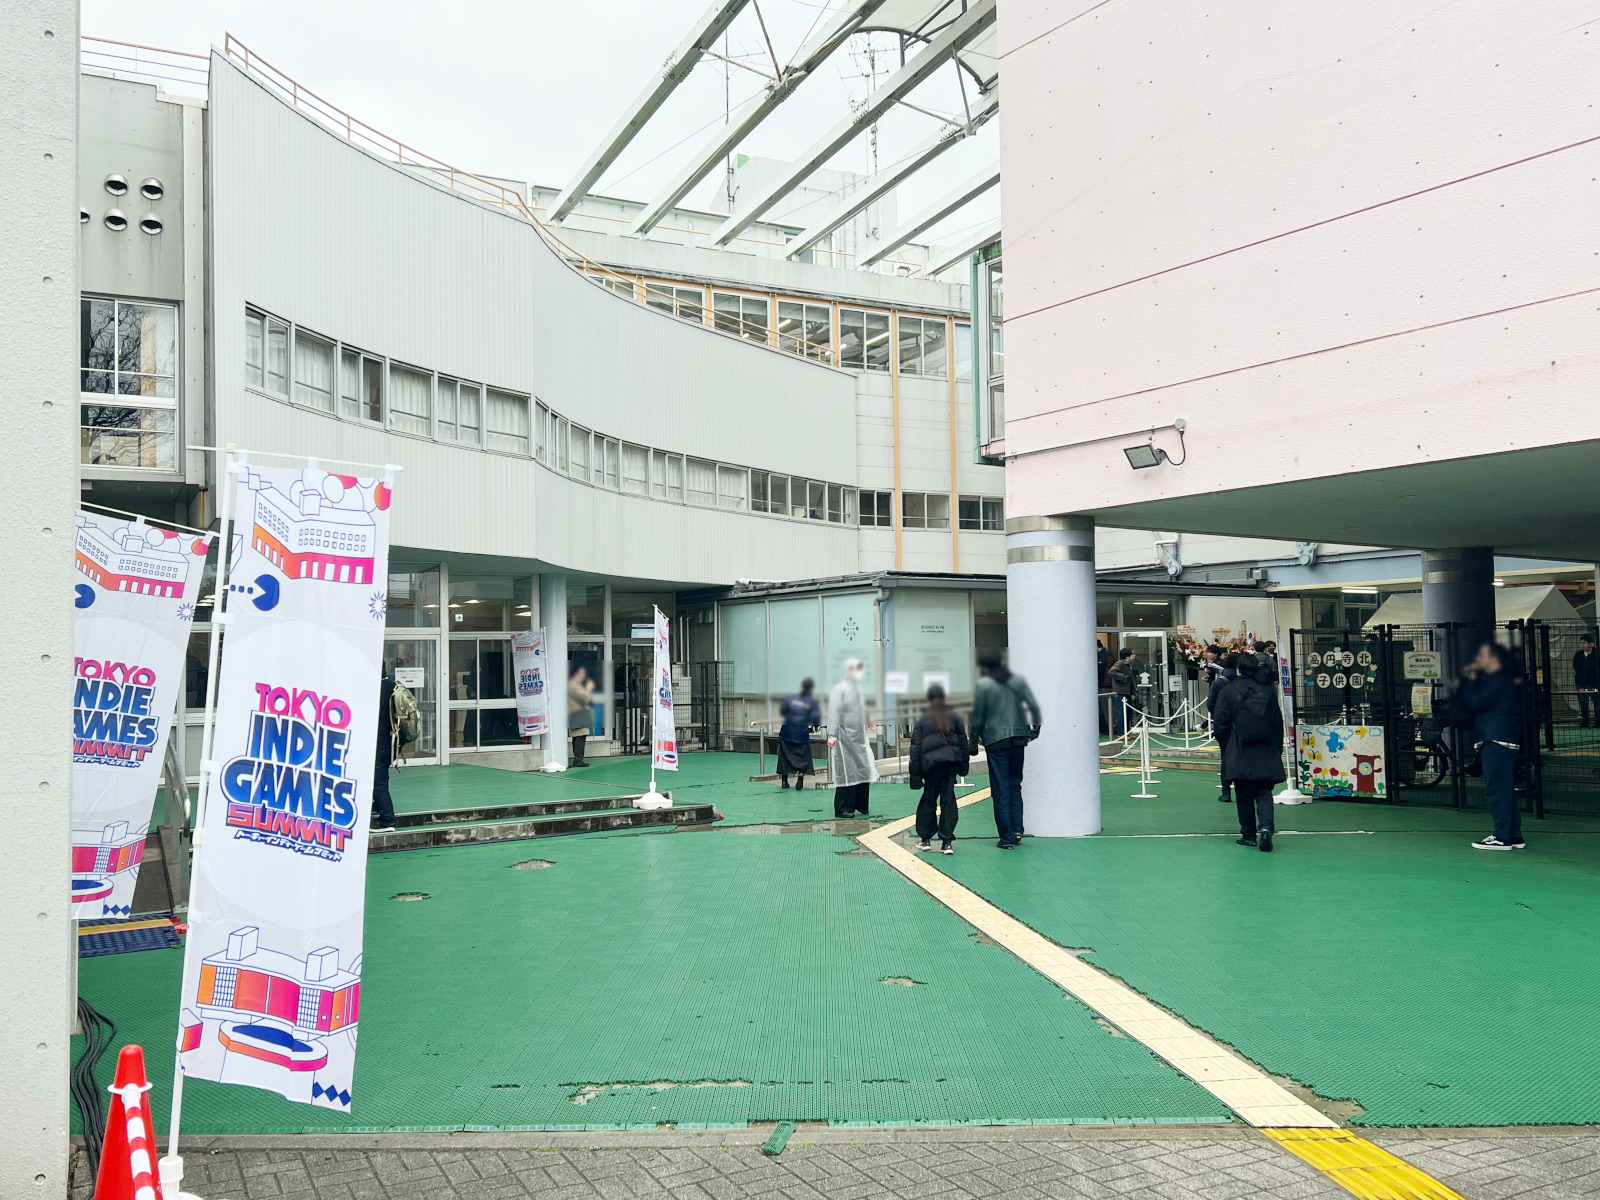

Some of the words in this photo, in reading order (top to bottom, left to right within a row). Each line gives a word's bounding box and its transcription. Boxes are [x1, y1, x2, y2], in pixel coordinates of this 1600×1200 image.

[1309, 652, 1370, 666] 高円寺北
[73, 678, 154, 716] NDIE
[1317, 675, 1362, 686] 子供園
[255, 682, 351, 730] TOKYO
[73, 709, 158, 747] AMES
[248, 713, 350, 778] INDIE
[73, 739, 153, 761] MMIT
[222, 758, 356, 828] GAMES
[226, 803, 352, 852] SUMMIT
